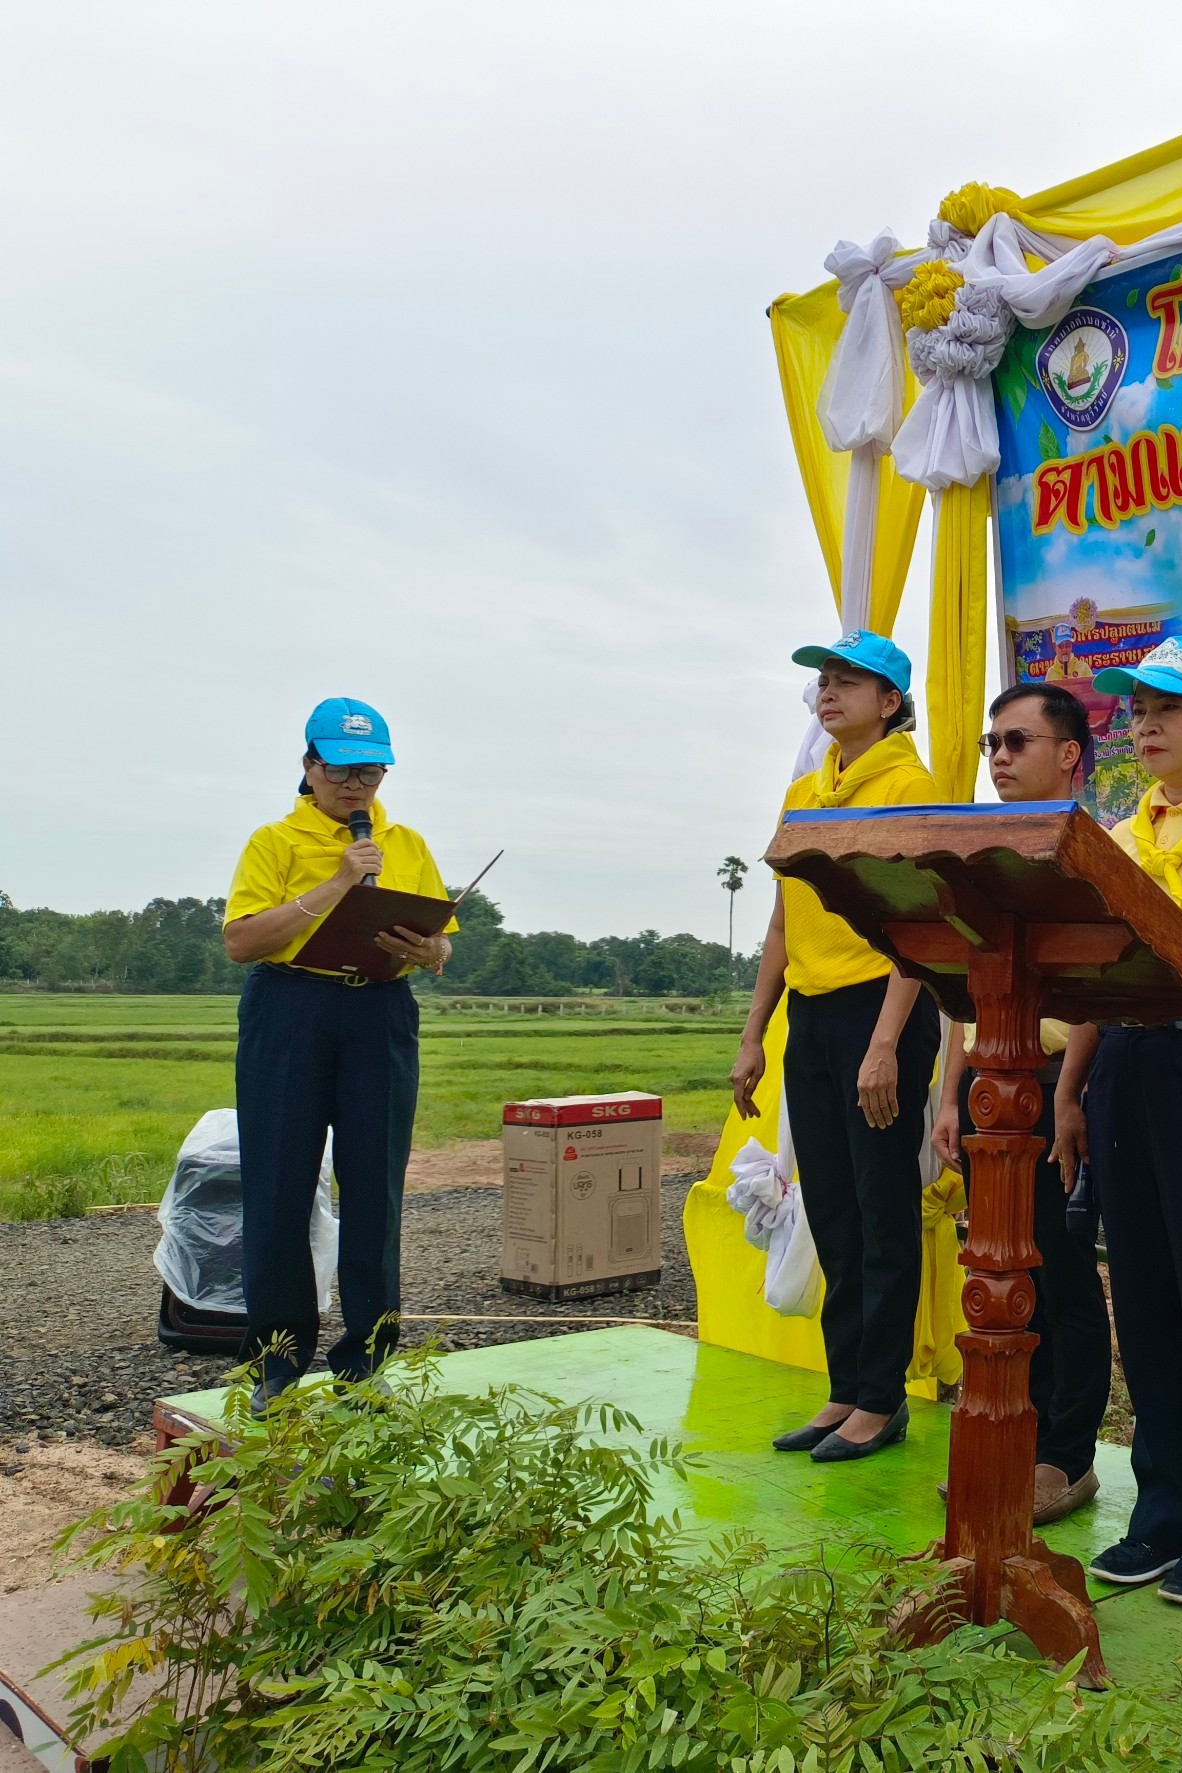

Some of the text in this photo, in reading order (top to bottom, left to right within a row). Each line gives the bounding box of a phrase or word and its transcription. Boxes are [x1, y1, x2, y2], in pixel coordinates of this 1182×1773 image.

[515, 1108, 542, 1120] SKG
[591, 1104, 632, 1118] SKG
[567, 1129, 603, 1141] KG-058
[563, 1284, 596, 1297] KG-058
